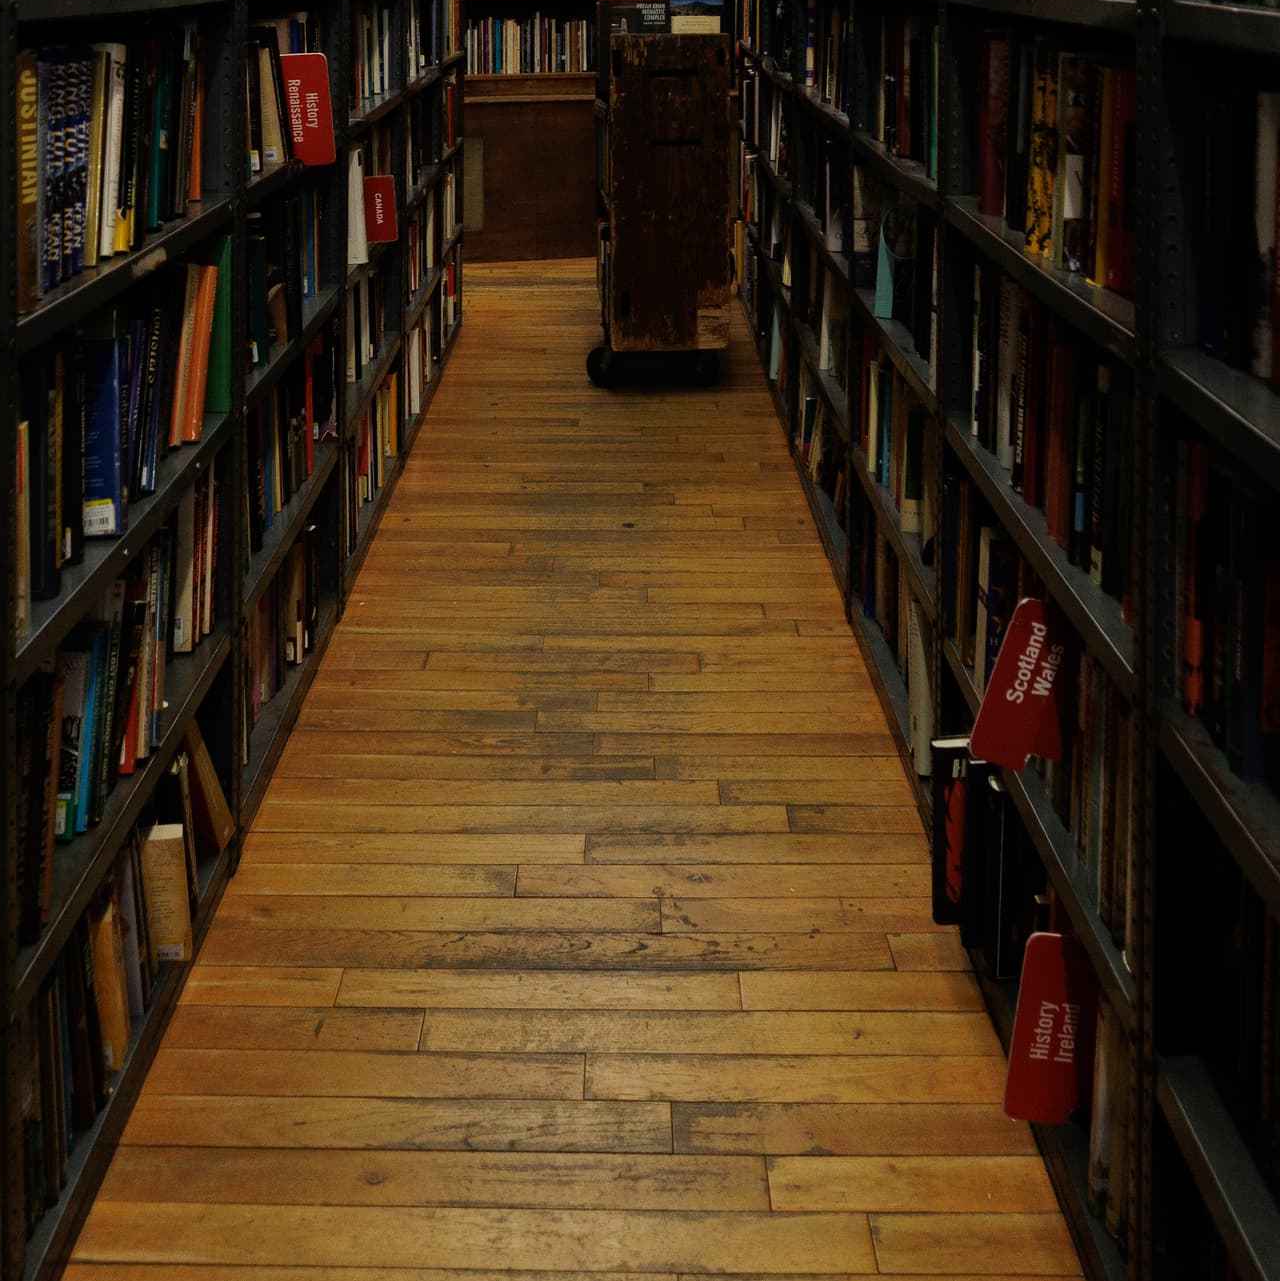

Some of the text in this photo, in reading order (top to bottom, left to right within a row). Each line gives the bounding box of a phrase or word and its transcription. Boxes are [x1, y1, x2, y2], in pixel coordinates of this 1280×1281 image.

[20, 68, 40, 205] JUSTINIAN
[287, 79, 304, 143] Renaissance
[305, 92, 319, 129] History
[62, 61, 79, 254] KING TUT KEAN
[49, 212, 63, 261] KEAN
[374, 192, 384, 225] CANADA
[1005, 621, 1048, 705] Scotland
[1031, 643, 1065, 697] Wales
[1029, 999, 1059, 1061] History
[1053, 1002, 1081, 1063] Ireland
